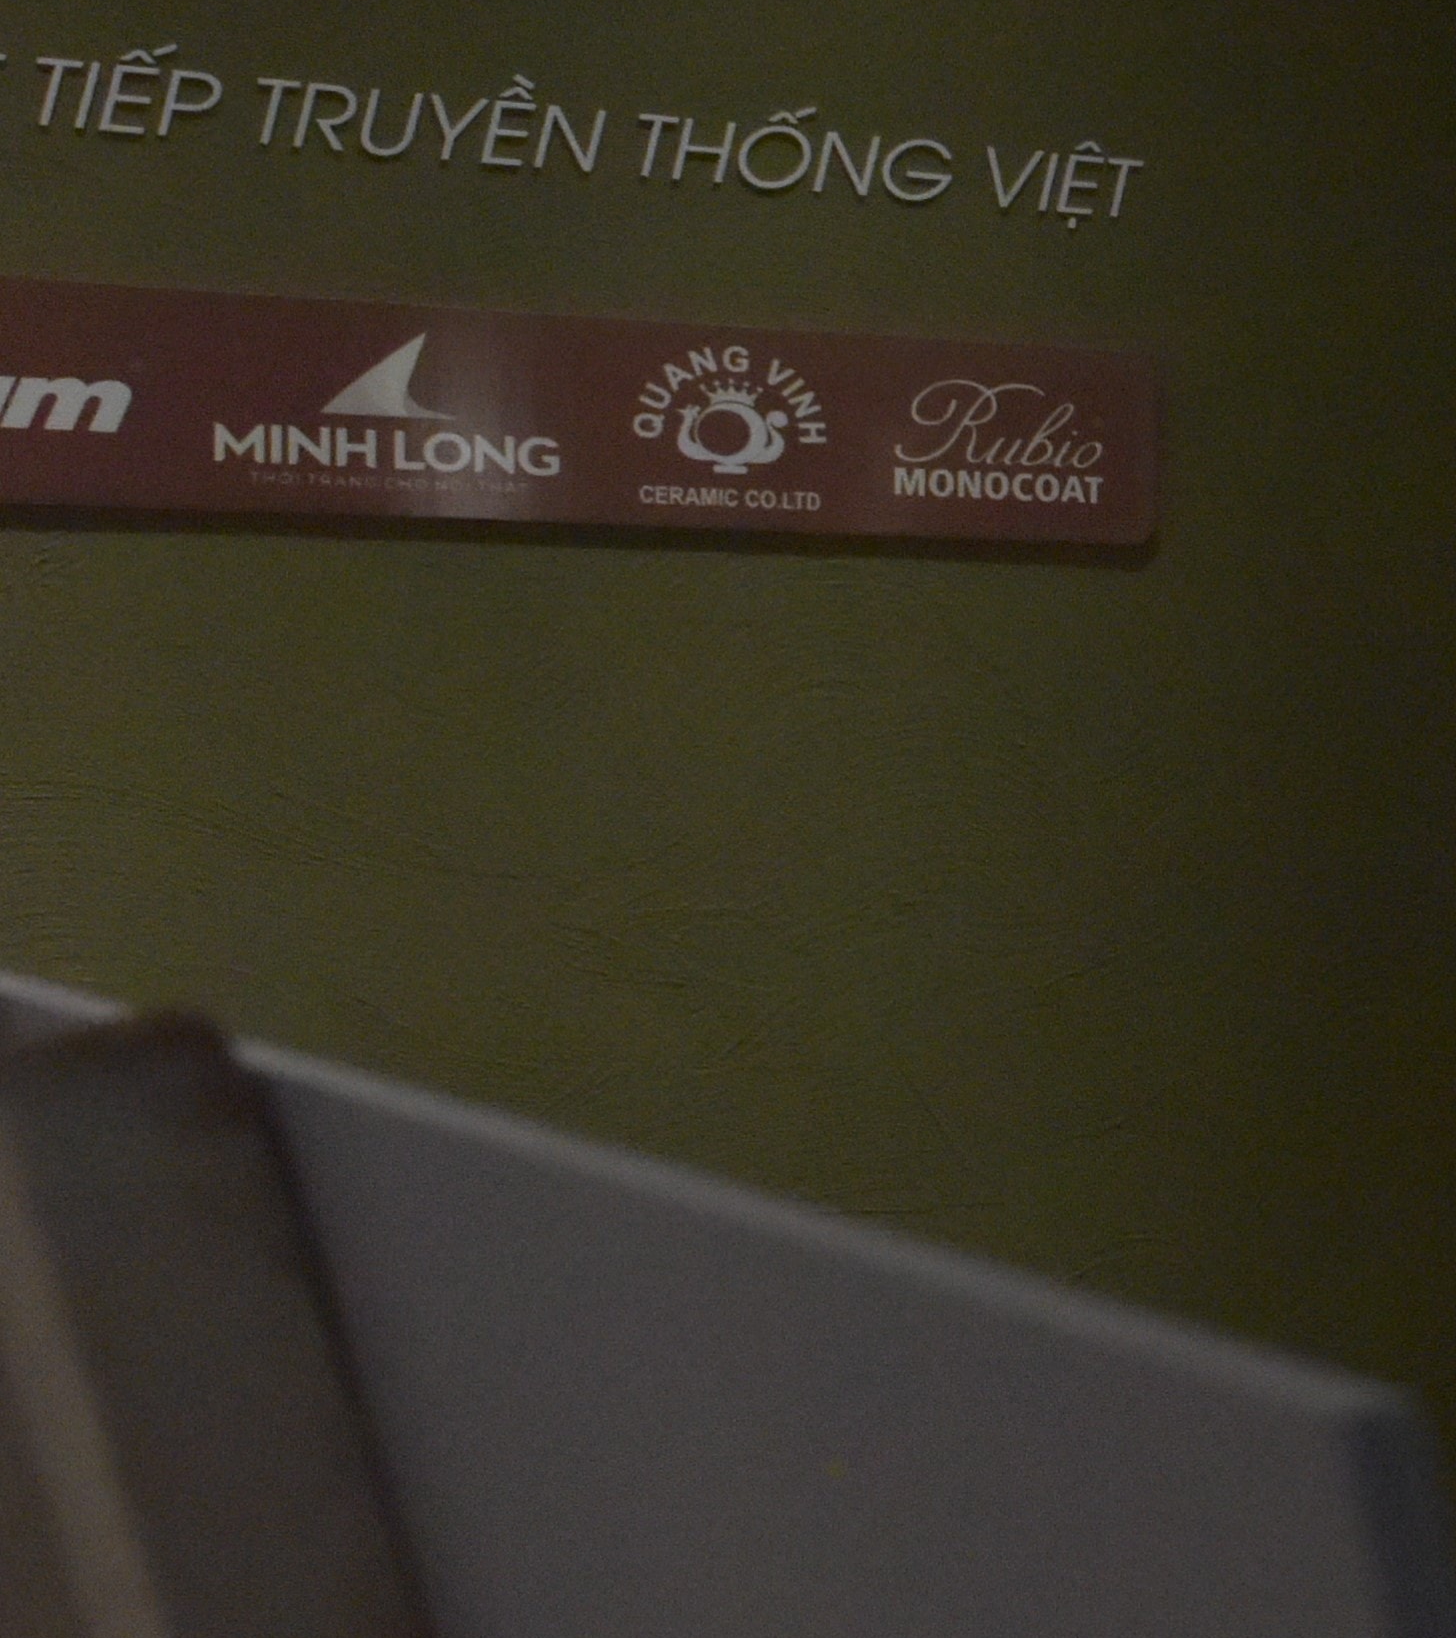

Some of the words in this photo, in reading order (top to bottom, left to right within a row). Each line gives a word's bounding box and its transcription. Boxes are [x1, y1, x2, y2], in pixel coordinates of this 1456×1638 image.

[36, 43, 223, 137] TIẾP
[256, 74, 606, 173] TRUYỀN
[638, 106, 954, 202] THỐNG
[986, 141, 1145, 229] VIỆT
[633, 346, 751, 440] QUANG
[765, 359, 828, 445] VINH
[893, 379, 1104, 469] Rubio
[213, 421, 378, 469] MINH
[394, 429, 562, 477] LONG
[639, 485, 739, 508] CERAMIC
[893, 467, 1104, 505] MONOCOAT
